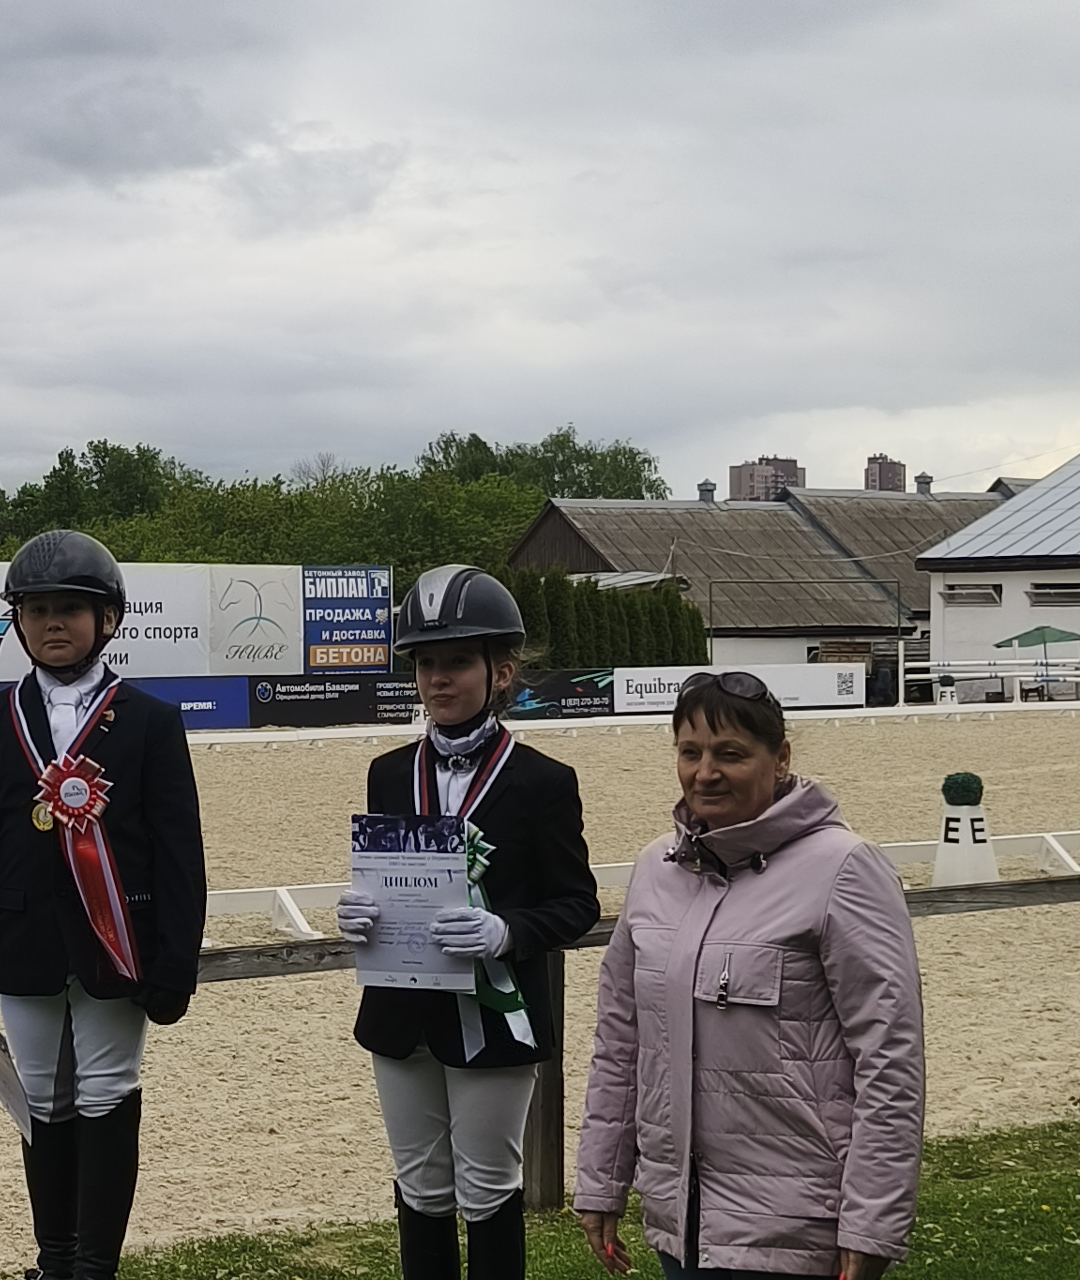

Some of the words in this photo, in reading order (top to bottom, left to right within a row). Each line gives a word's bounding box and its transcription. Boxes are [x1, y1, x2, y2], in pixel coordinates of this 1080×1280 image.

[344, 570, 366, 578] ЗАВОД
[305, 577, 368, 598] БИПЛАН
[124, 601, 163, 616] ация
[306, 608, 372, 622] ПРОДАЖА
[144, 626, 199, 644] спорта
[321, 631, 330, 640] И
[332, 629, 386, 642] ДОСТАВКА
[316, 647, 385, 664] БЕТОНА
[275, 682, 325, 693] Автомобили
[325, 682, 360, 693] Баварии
[625, 677, 683, 699] Equibra
[939, 690, 947, 702] F
[950, 690, 956, 702] F
[180, 701, 217, 711] ВРЕМЯ:
[413, 709, 420, 721] P
[943, 816, 961, 844] E
[970, 817, 988, 844] E
[381, 876, 438, 888] ДИПЛОМ
